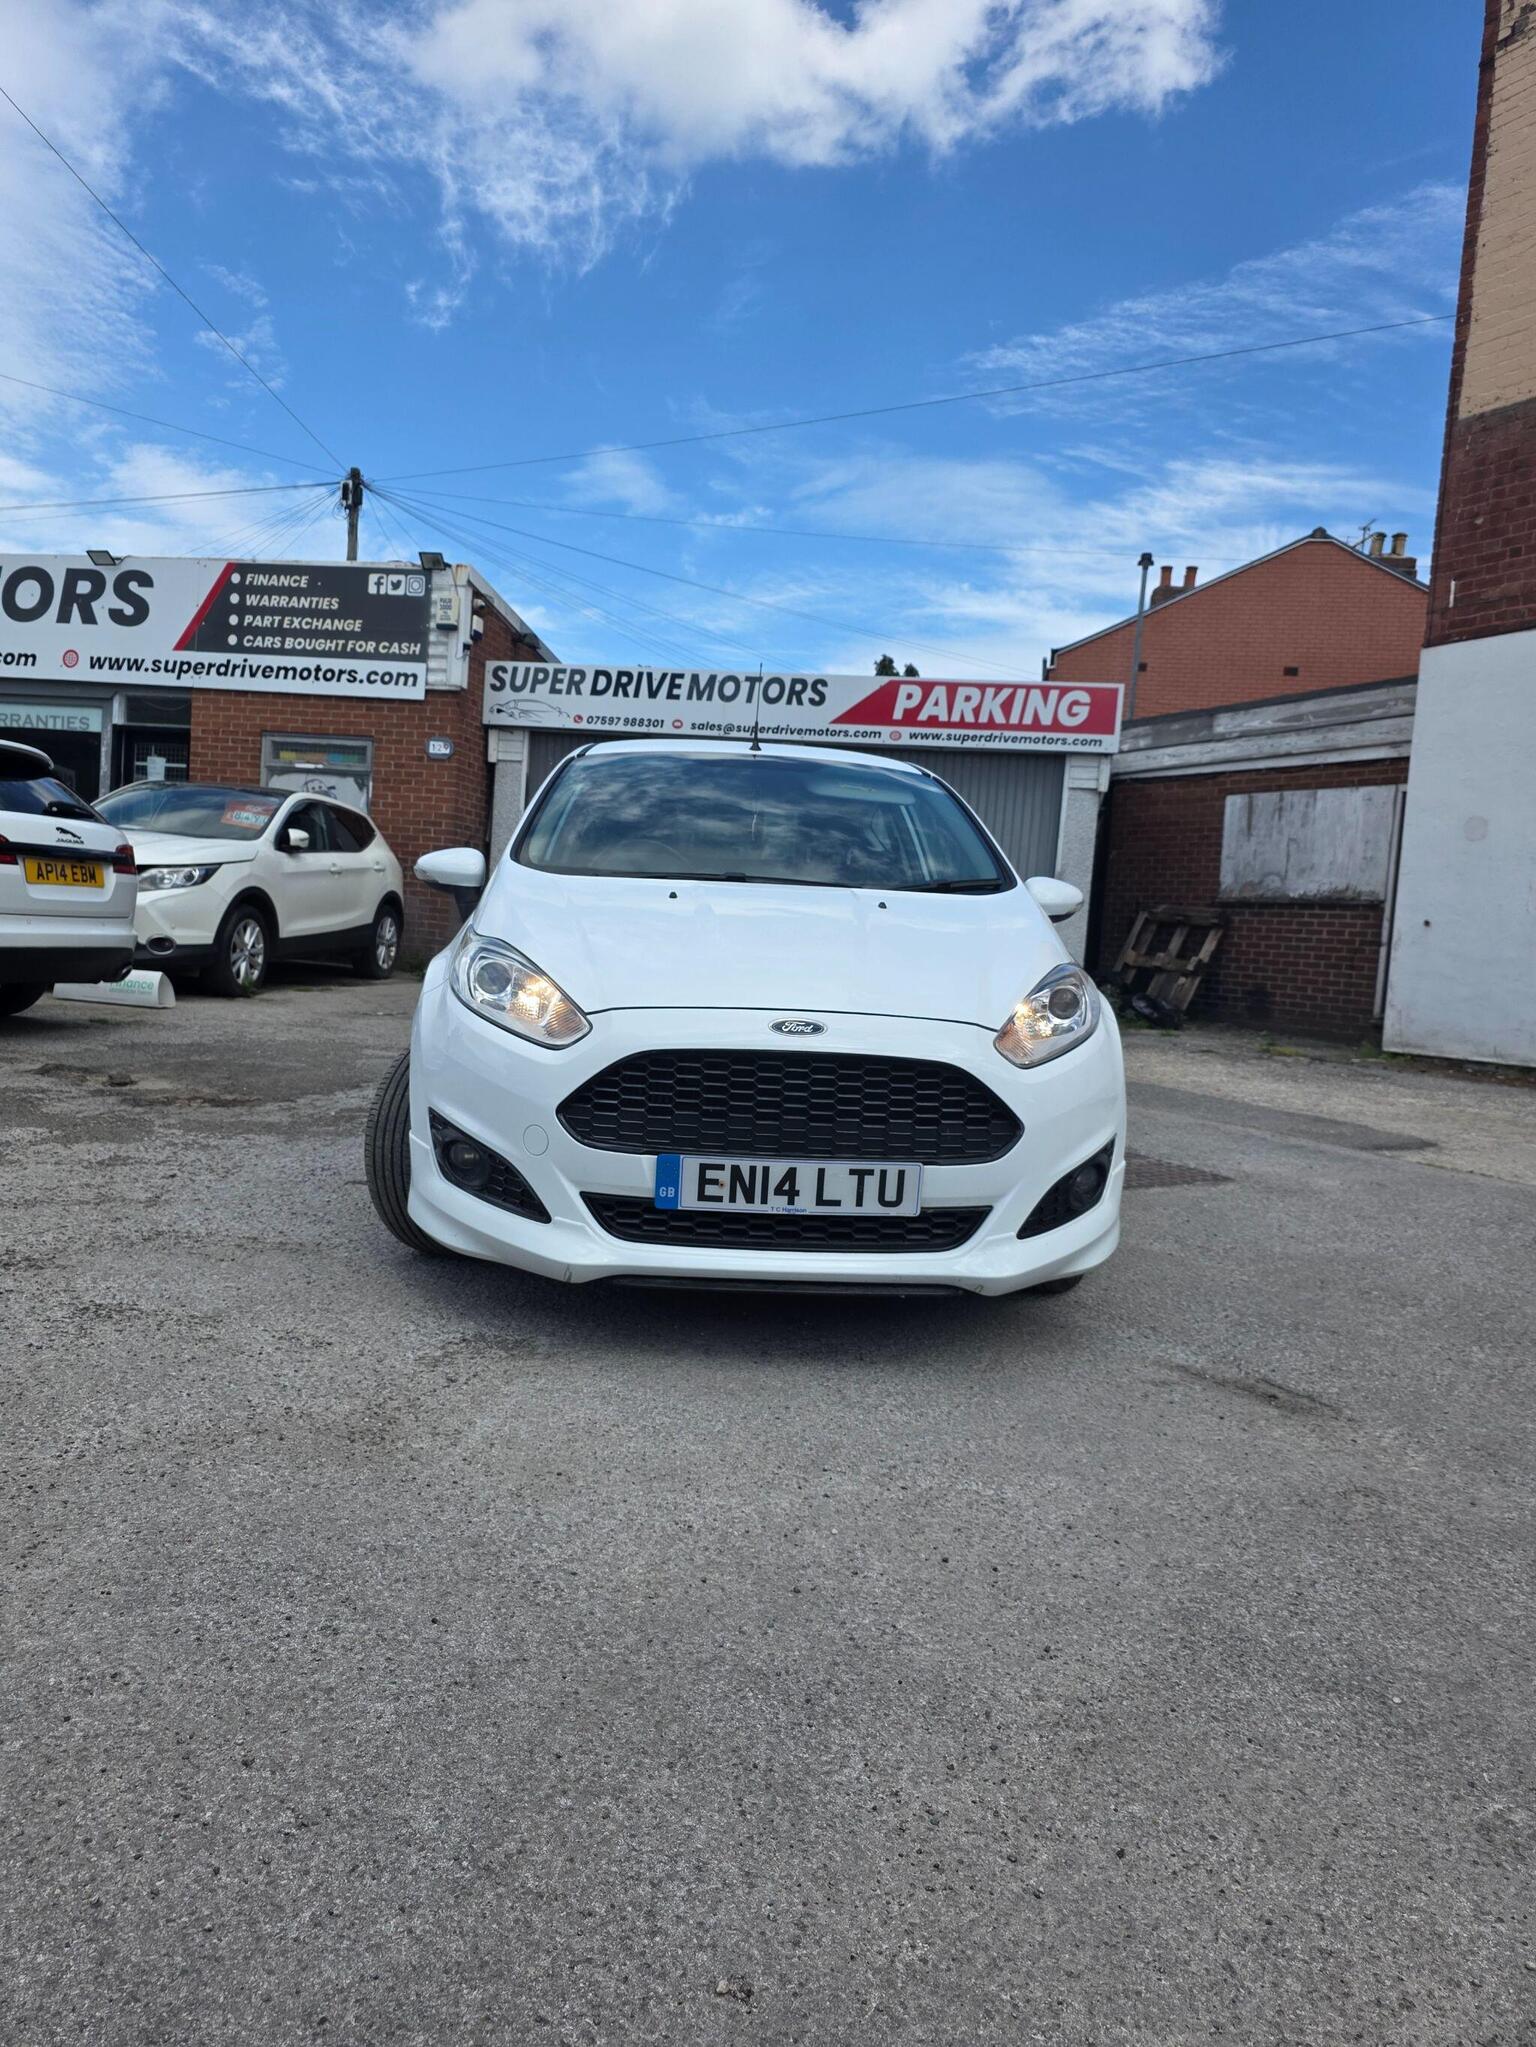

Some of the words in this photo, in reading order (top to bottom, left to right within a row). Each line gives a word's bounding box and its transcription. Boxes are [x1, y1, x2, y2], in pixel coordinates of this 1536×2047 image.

[245, 573, 309, 588] FINANCE
[0, 566, 154, 627] ORS
[245, 594, 340, 610] WARRANTIES
[243, 615, 282, 628] PART
[283, 617, 363, 632] EXCHANGE
[243, 635, 282, 649] CARS
[284, 637, 345, 652] BOUGHT
[346, 640, 376, 653] FOR
[378, 642, 421, 656] CASH
[0, 651, 37, 667] om
[89, 654, 419, 688] www.superdrivemotors.com
[892, 684, 1092, 727] PARKING
[586, 715, 620, 727] 07597
[622, 716, 665, 729] 988301
[690, 720, 882, 739] sales@superdrivemotors.com
[908, 730, 1103, 747] www.superdrivemotors.com
[36, 862, 68, 881] AP14
[70, 864, 97, 883] EBM
[781, 1021, 813, 1033] Ford
[659, 1186, 675, 1198] GB
[696, 1162, 800, 1206] EN14
[815, 1167, 906, 1208] LTU
